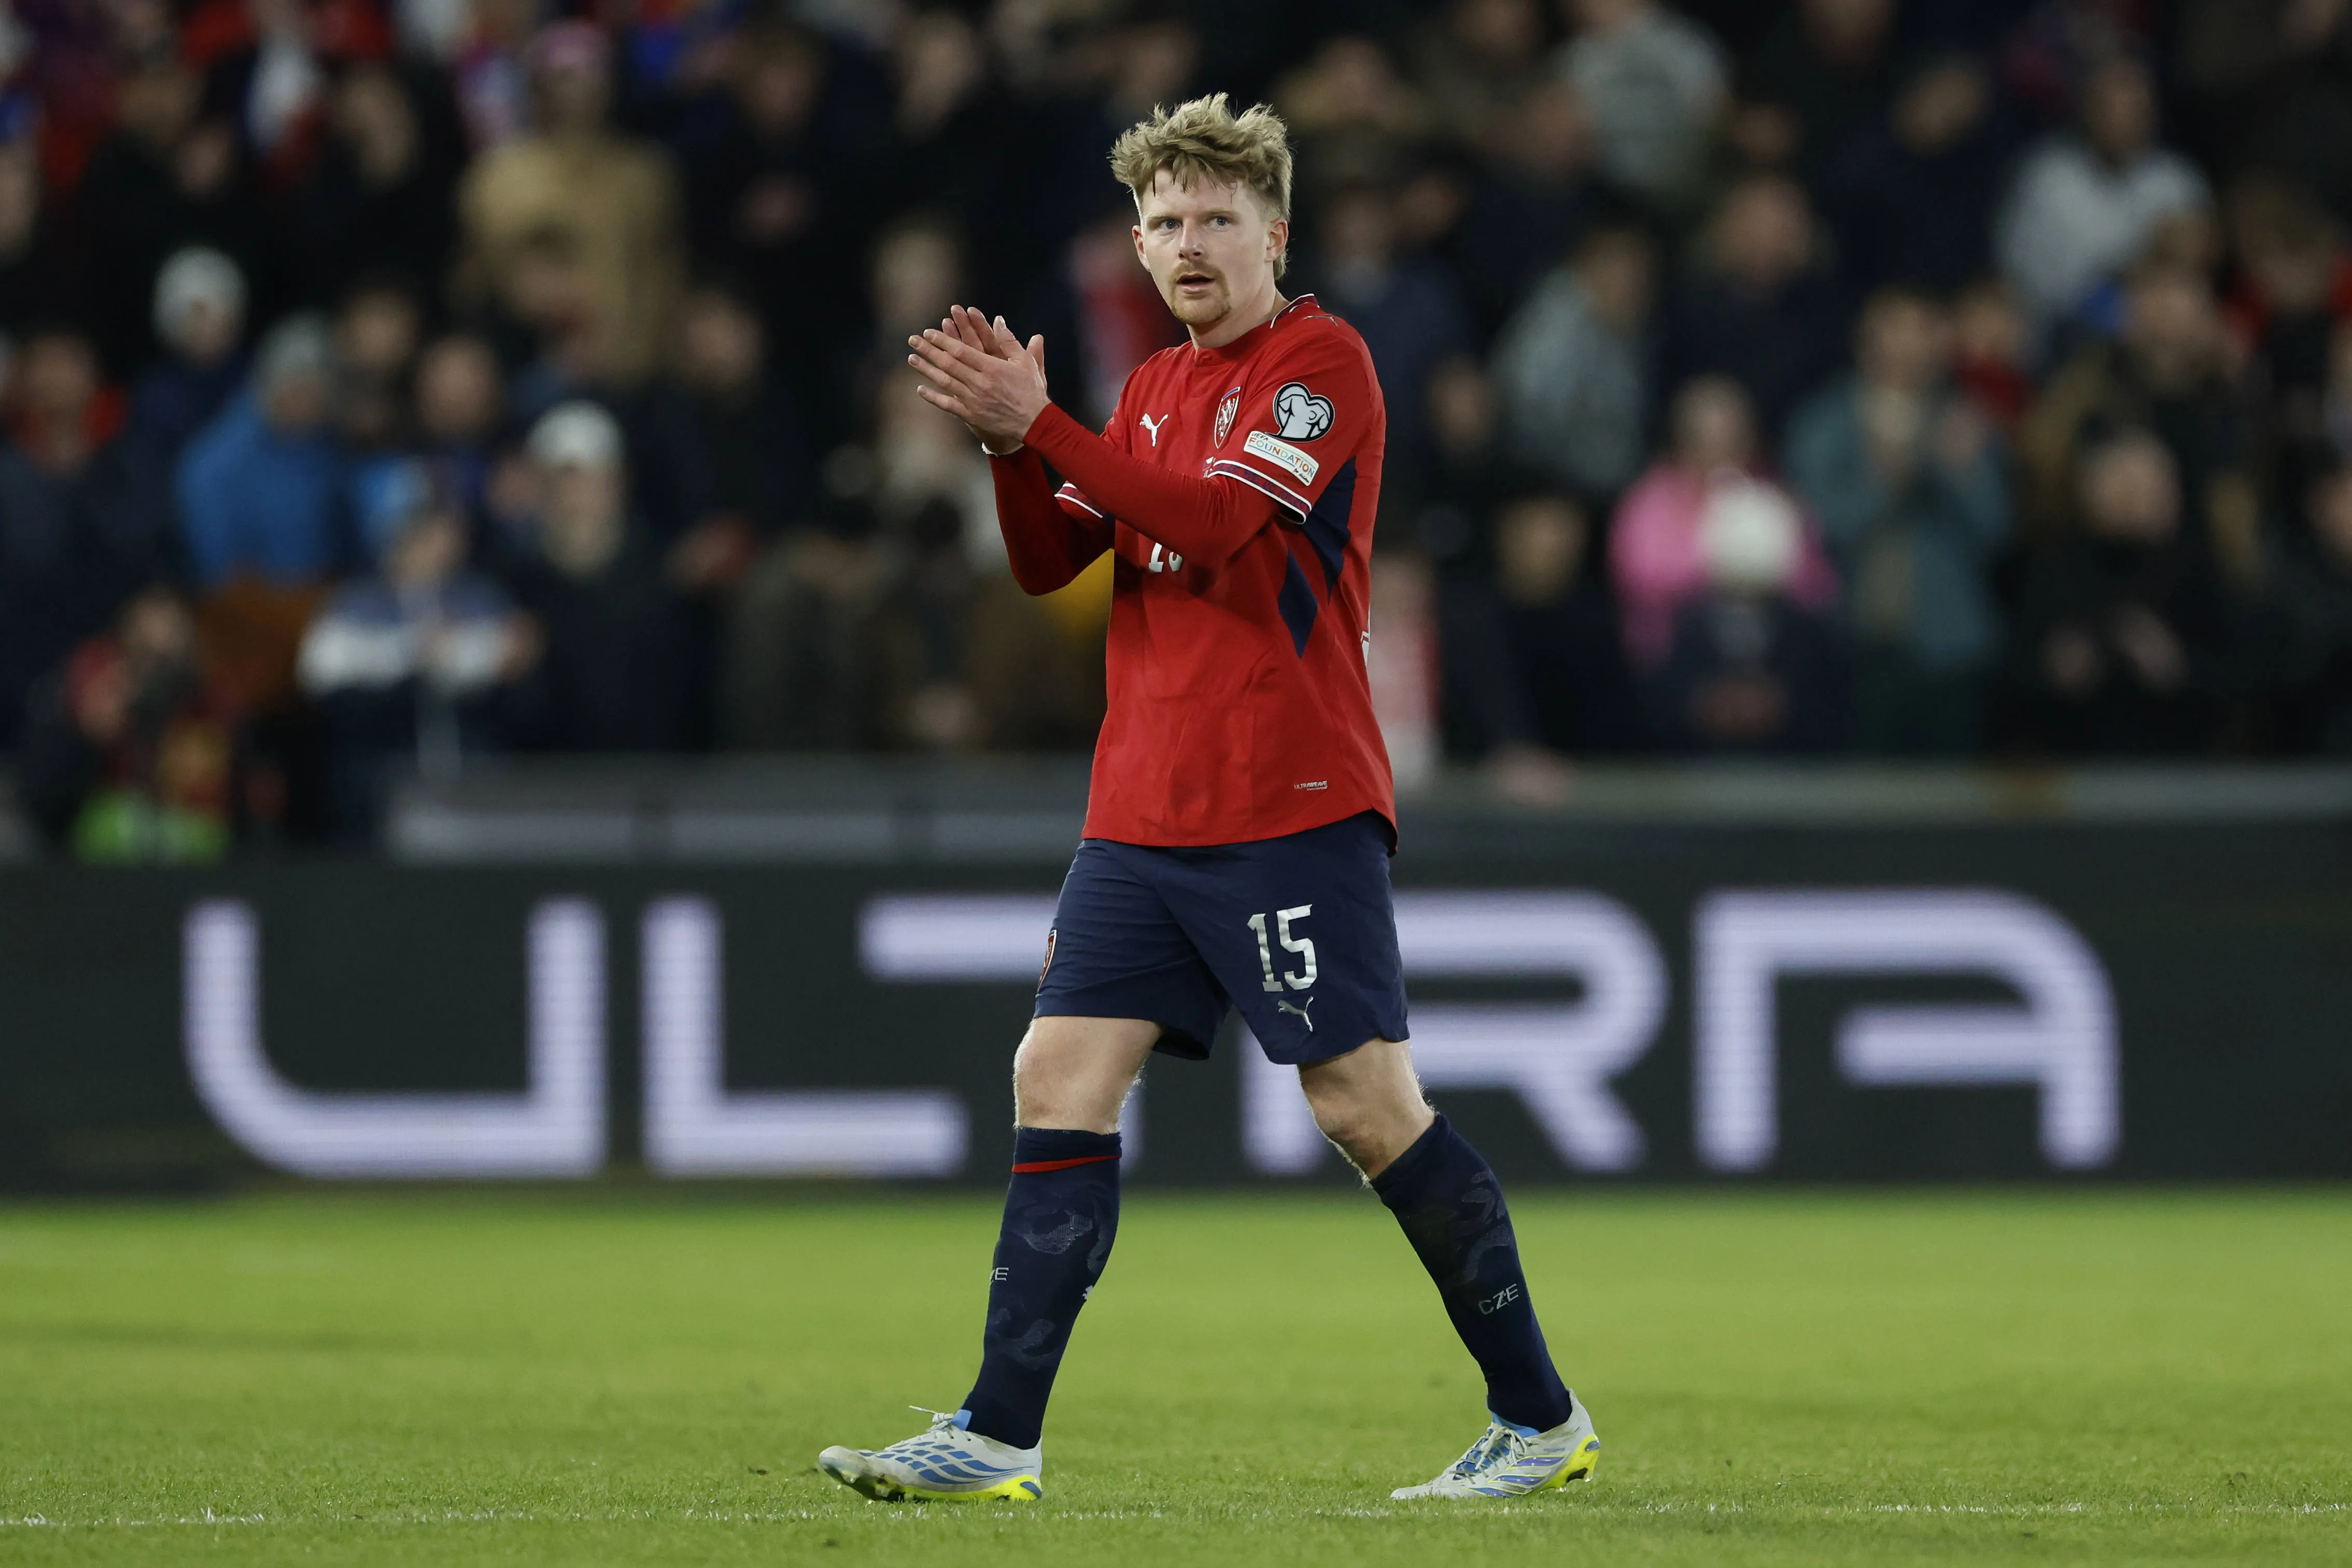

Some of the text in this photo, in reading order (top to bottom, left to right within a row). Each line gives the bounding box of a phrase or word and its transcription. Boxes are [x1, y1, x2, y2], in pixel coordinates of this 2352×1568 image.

[1251, 432, 1269, 441] UEFA
[1249, 437, 1315, 478] FOUNDATION
[1247, 904, 1317, 992] 15
[1478, 1283, 1519, 1314] CZE
